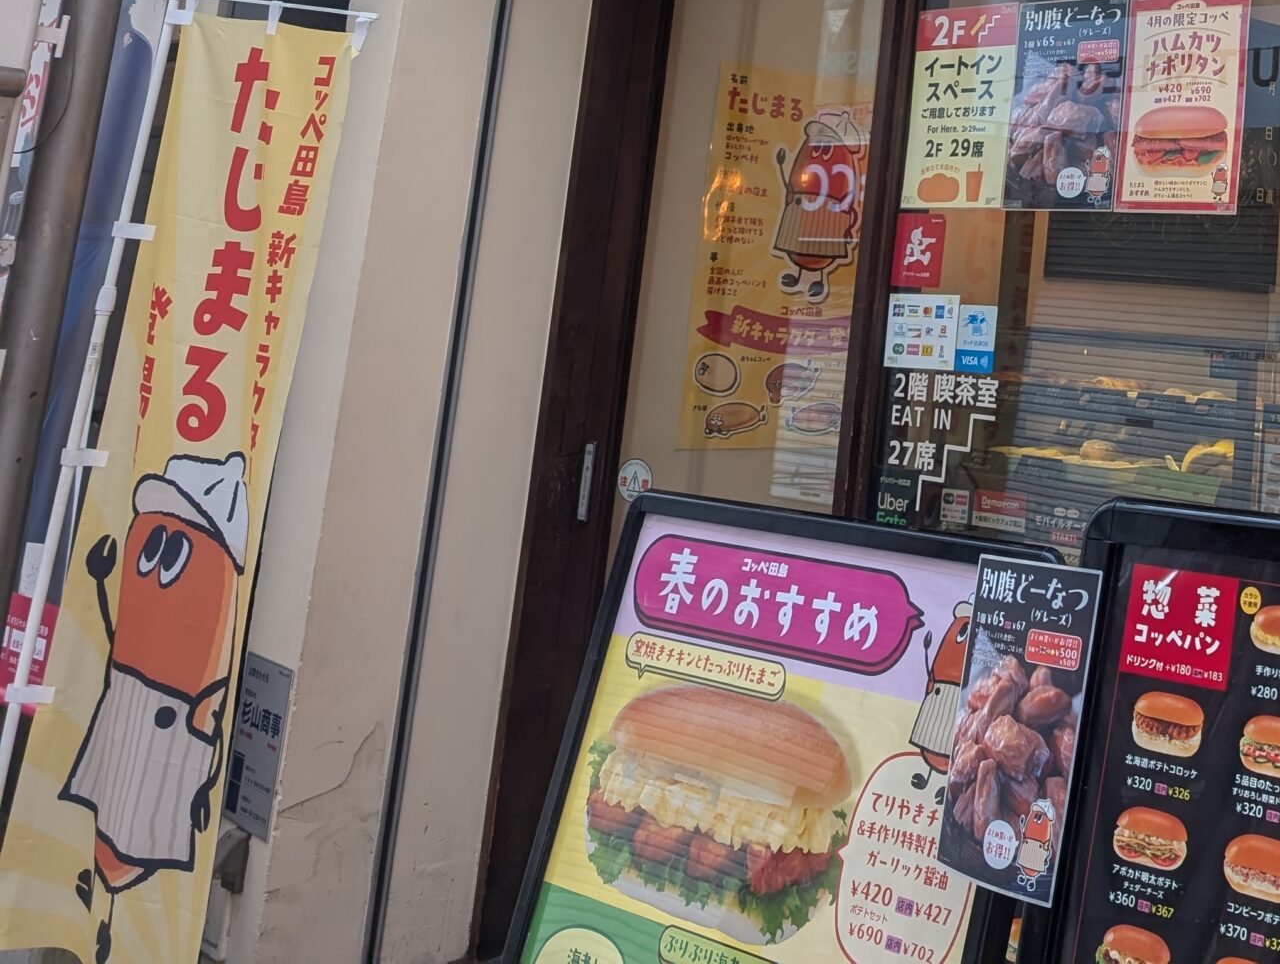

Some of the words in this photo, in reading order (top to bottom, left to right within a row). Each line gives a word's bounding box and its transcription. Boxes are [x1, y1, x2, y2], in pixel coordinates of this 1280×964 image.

[931, 15, 967, 46] 2F
[1025, 5, 1121, 32] 別腹どーなつ
[1146, 11, 1230, 28] 4月の限定コッペ
[1078, 26, 1111, 37] (グレーズ)
[1151, 31, 1222, 57] ハムカツ
[924, 54, 1003, 77] イートイン
[1145, 53, 1226, 82] ナポリタン
[926, 80, 994, 102] スペース
[1158, 83, 1183, 93] ¥420
[1191, 86, 1212, 95] ¥690
[728, 86, 804, 122] たじまる
[921, 105, 996, 119] ご用意しております
[278, 56, 337, 217] コッペ田島
[927, 125, 939, 134] For
[941, 125, 959, 133] Here.
[924, 139, 943, 158] 2F
[949, 138, 985, 158] 29席
[176, 46, 281, 443] たじまる
[780, 306, 822, 317] コッペ田島
[731, 314, 850, 347] 新キャラクター登
[248, 230, 297, 488] 新キャラクター
[961, 356, 978, 366] VISA
[894, 374, 928, 403] 2階
[933, 375, 999, 408] 喫茶室
[891, 405, 923, 428] EAT
[933, 408, 952, 430] IN
[888, 440, 937, 472] 27席
[878, 492, 909, 512] Uber
[876, 512, 907, 526] Eats
[1052, 532, 1078, 542] START!
[741, 557, 789, 578] コッペ田島
[658, 547, 879, 651] 春のおすすめ
[980, 568, 1089, 611] 別腹どーなつ
[1243, 592, 1259, 600] カラシ
[987, 611, 1006, 627] ¥65
[1031, 608, 1072, 628] (グレーズ)
[1134, 623, 1220, 655] コッペパン
[632, 639, 781, 687] 窯焼きチキンとたっぷりたまご
[1126, 654, 1164, 672] ドリンク付
[1203, 671, 1223, 682] ¥183
[1250, 686, 1278, 701] ¥280
[241, 698, 283, 740] 杉山商事
[1125, 753, 1199, 780] 北海道ポテトコロッケ
[1126, 775, 1152, 791] ¥320
[1168, 785, 1191, 801] ¥326
[1236, 802, 1263, 819] ¥320
[986, 841, 1010, 860] お得!!
[866, 850, 949, 891] ガーリック醤油
[1112, 863, 1179, 891] アボカド明太ポテト
[1123, 881, 1165, 899] チェダーチーズ
[850, 904, 888, 924] ポテトセット
[851, 879, 893, 907] ¥420
[896, 897, 914, 916] 店内
[914, 901, 952, 927] ¥427
[1109, 891, 1136, 908] ¥360
[1151, 903, 1174, 919] ¥367
[848, 922, 884, 946] ¥690
[886, 937, 902, 953] 店内
[903, 942, 935, 964] ¥702
[1220, 923, 1248, 941] ¥370
